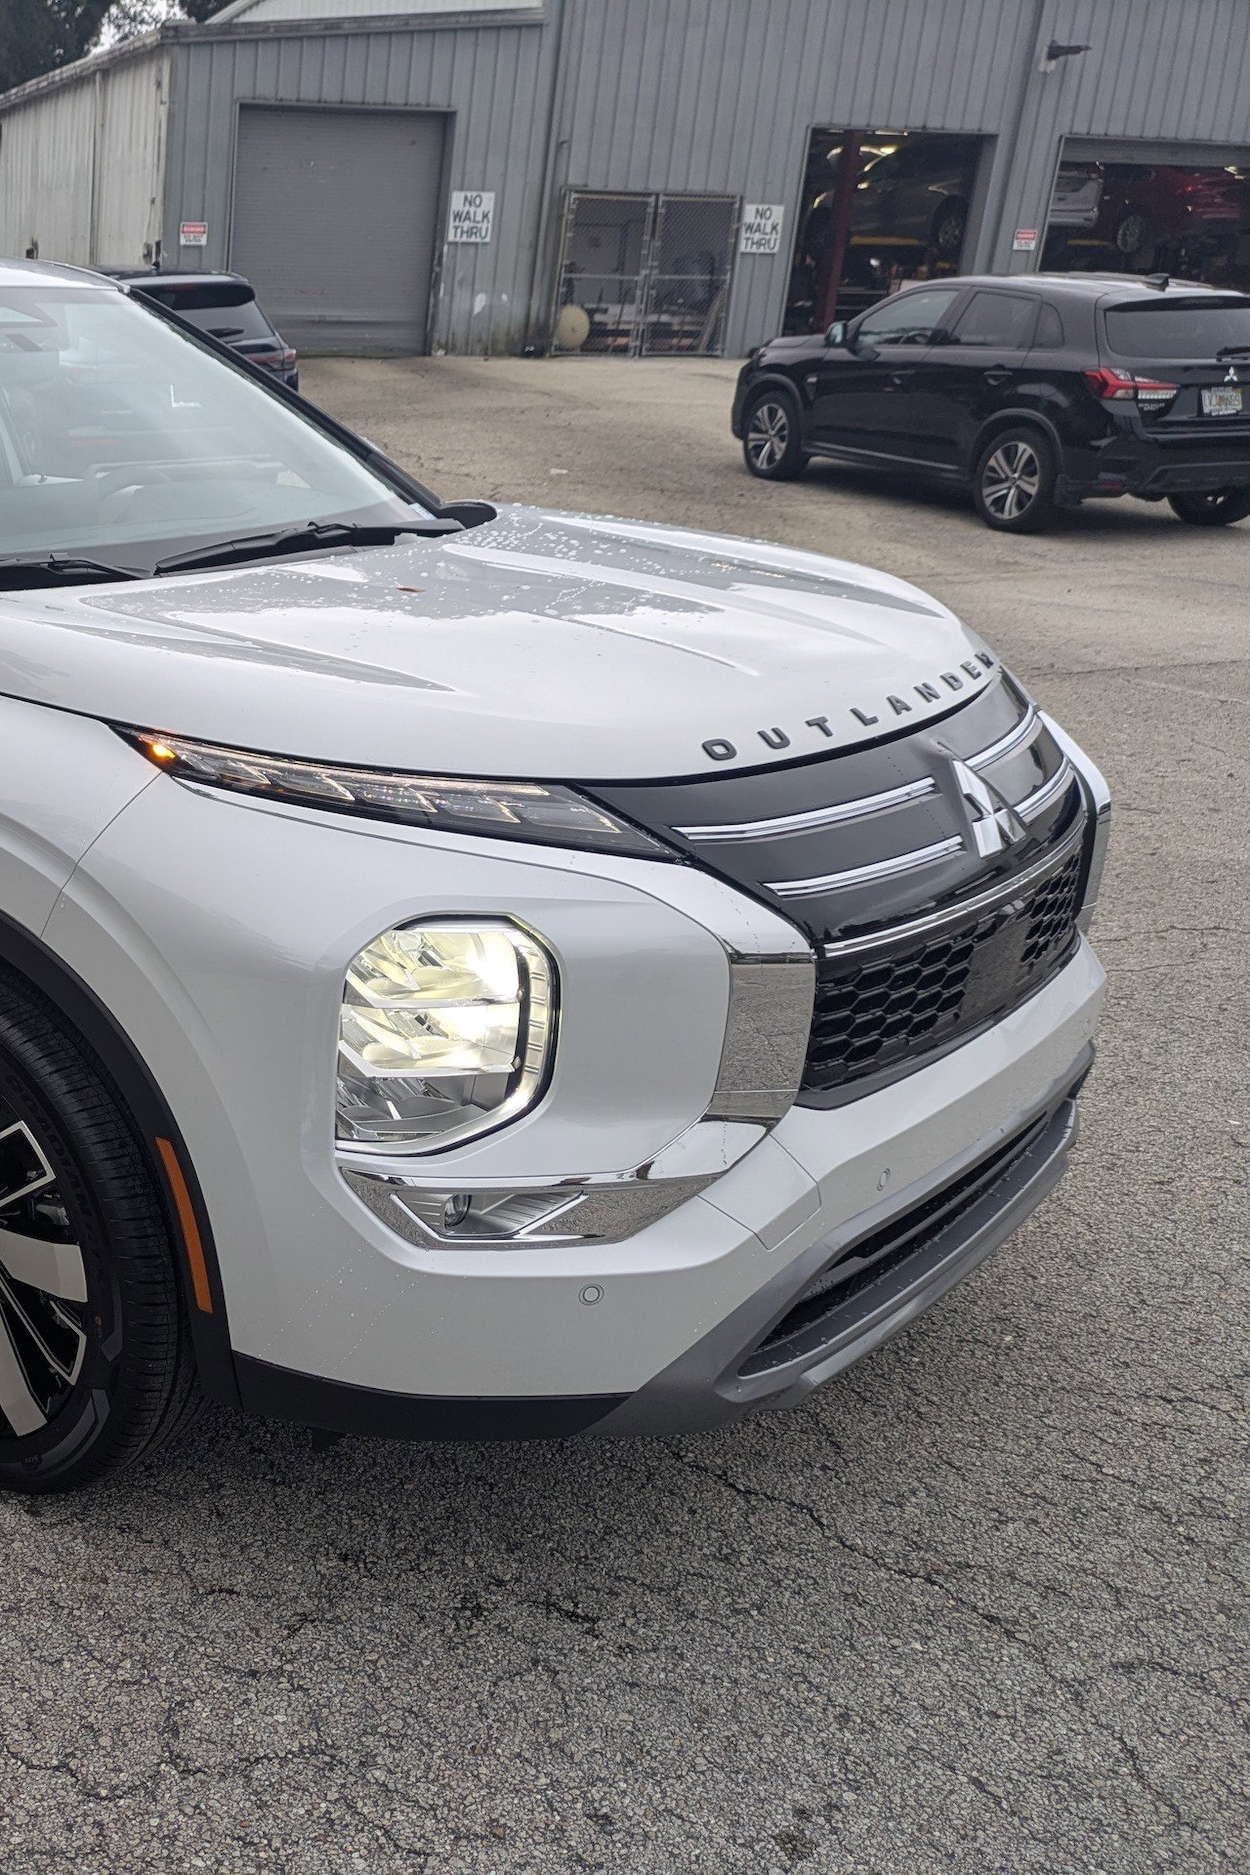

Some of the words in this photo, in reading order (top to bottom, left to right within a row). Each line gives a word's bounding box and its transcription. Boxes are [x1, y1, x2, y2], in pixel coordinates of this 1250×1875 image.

[463, 194, 483, 208] NO
[453, 210, 491, 224] WALK
[754, 206, 773, 221] NO
[452, 225, 489, 240] THRU
[743, 221, 779, 235] WALK
[743, 236, 778, 251] THRU
[702, 651, 994, 761] OUTLANDER
